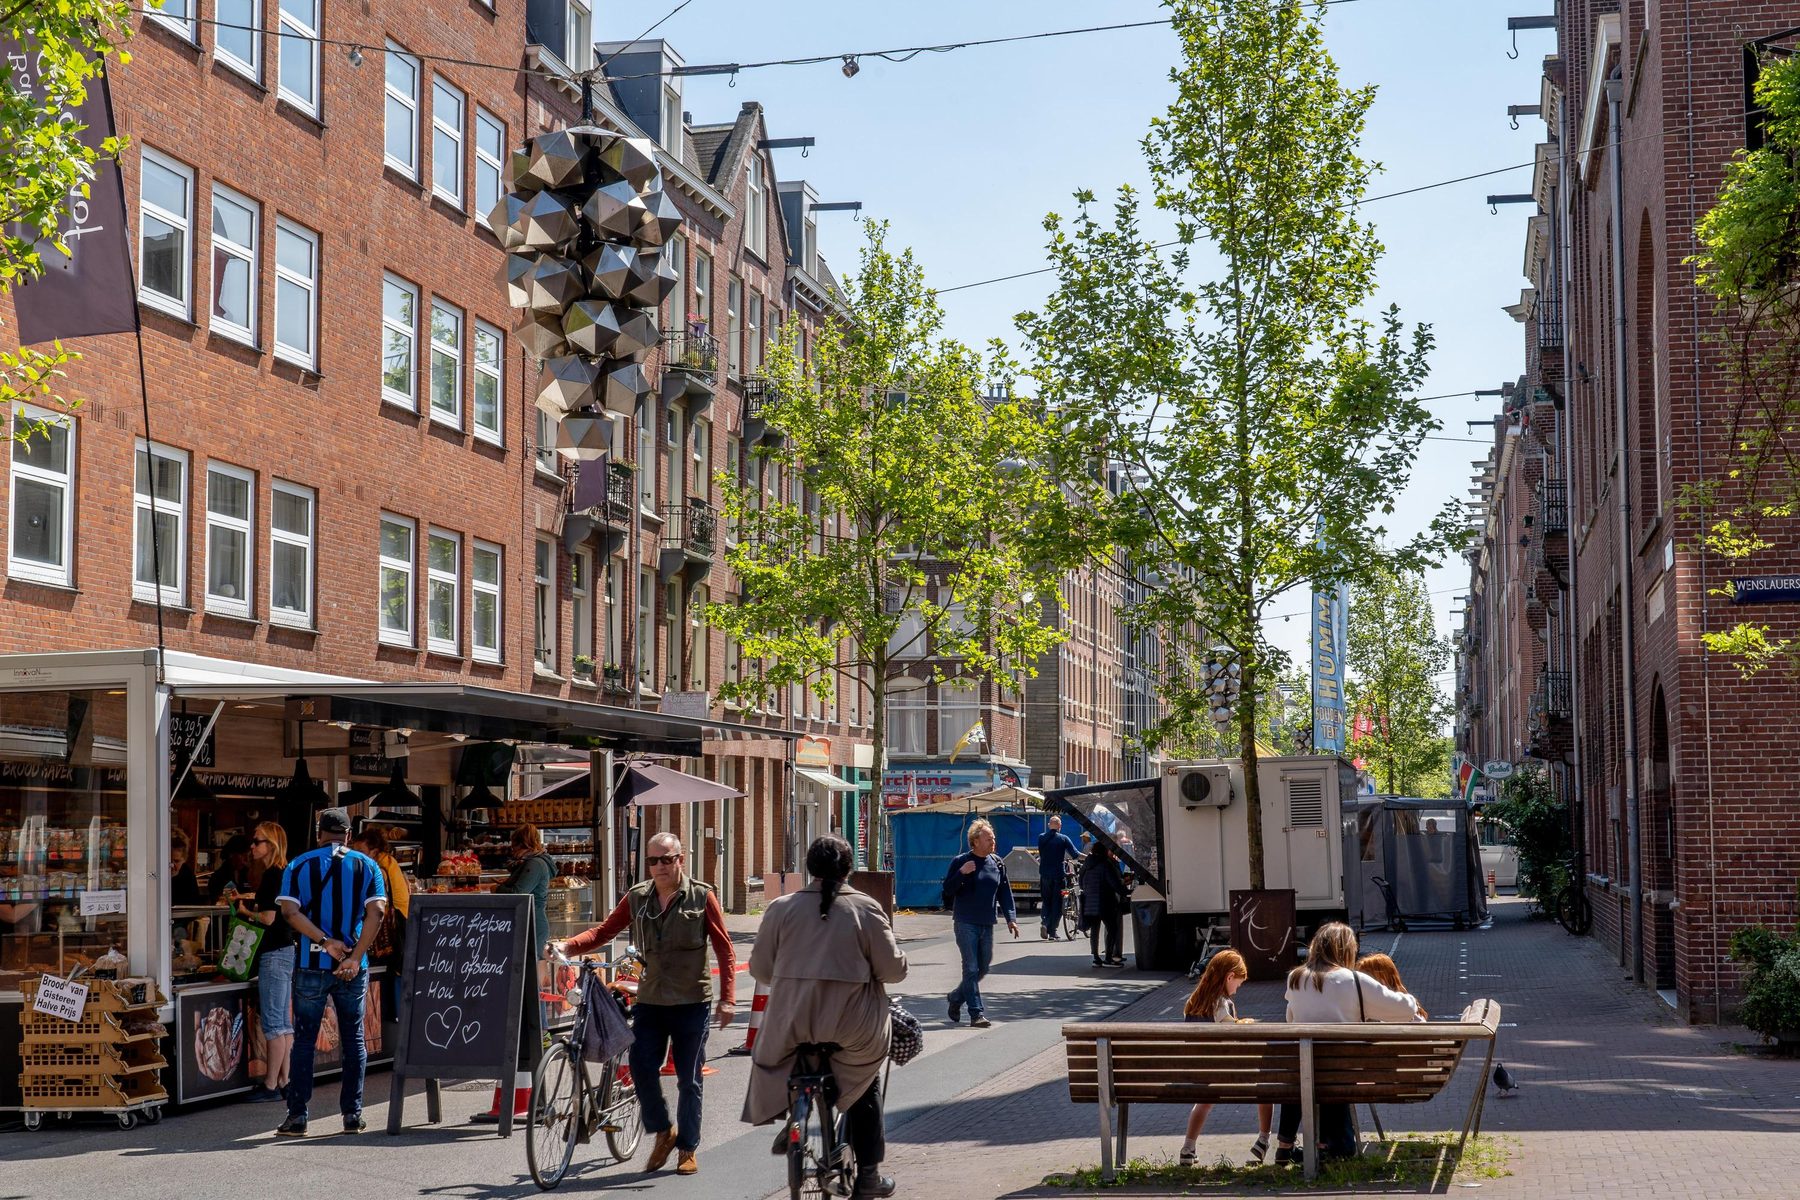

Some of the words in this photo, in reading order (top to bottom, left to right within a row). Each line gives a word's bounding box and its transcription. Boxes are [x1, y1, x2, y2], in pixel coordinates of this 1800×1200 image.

[884, 775, 952, 786] rchane
[465, 912, 512, 938] fietsen
[436, 934, 447, 947] in
[449, 934, 462, 948] de
[429, 952, 454, 973] Hou
[461, 956, 507, 982] afstand
[42, 975, 65, 990] Brood
[70, 985, 84, 997] van
[427, 980, 454, 999] Hou
[463, 978, 490, 999] vol
[43, 989, 76, 1006] Gisteren
[36, 998, 59, 1012] Halve
[60, 1004, 77, 1018] Prijs
